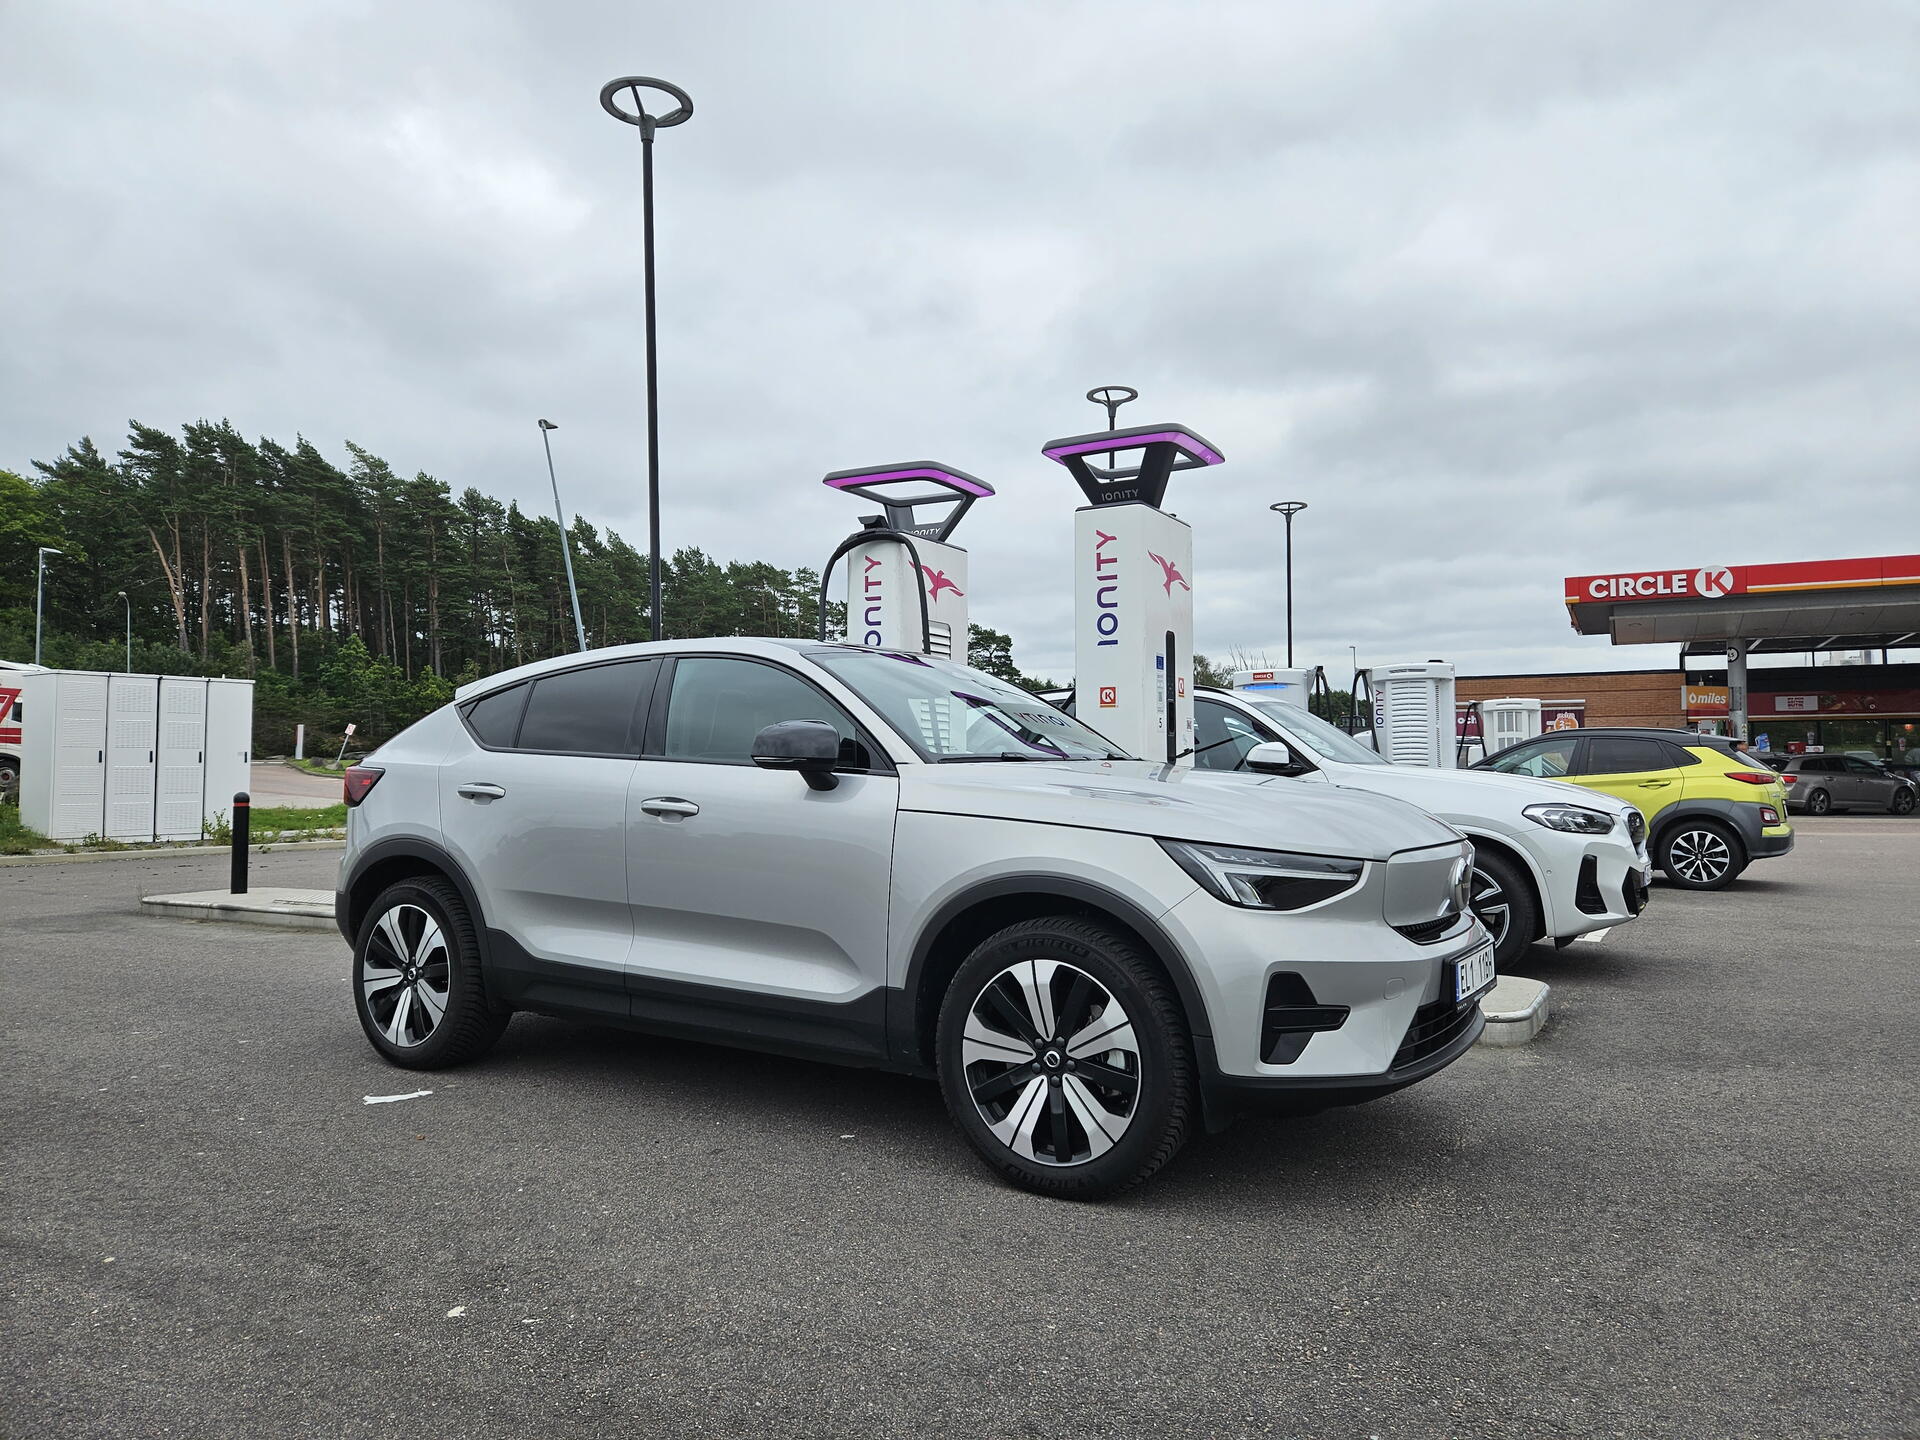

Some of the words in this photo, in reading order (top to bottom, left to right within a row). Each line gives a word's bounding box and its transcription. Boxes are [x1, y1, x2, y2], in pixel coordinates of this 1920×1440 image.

[1101, 488, 1139, 501] IONITY
[1095, 529, 1119, 646] IONITY
[1588, 573, 1688, 598] CIRCLE
[1703, 569, 1732, 597] K
[864, 555, 882, 647] ONITY
[1375, 689, 1384, 729] IONITY
[1697, 692, 1727, 704] miles
